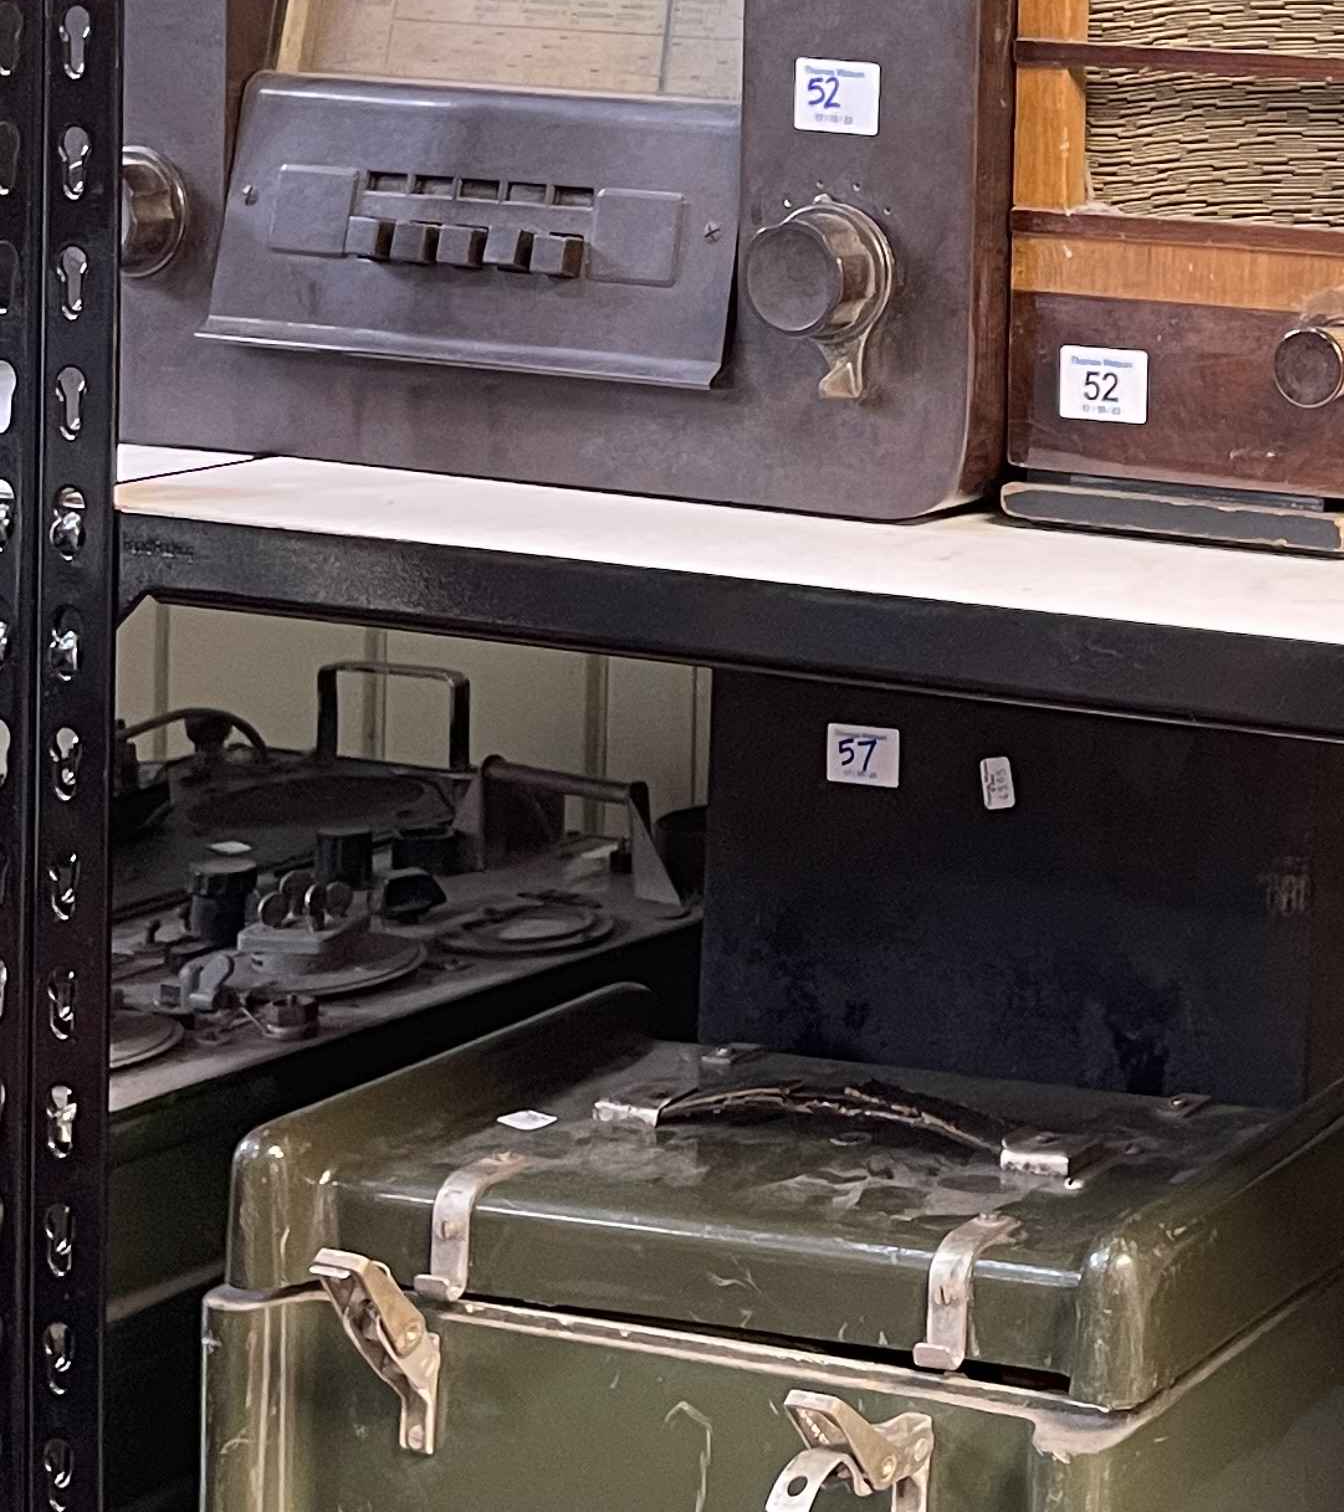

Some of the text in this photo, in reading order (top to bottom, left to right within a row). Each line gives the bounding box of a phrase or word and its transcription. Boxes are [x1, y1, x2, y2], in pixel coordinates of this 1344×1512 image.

[808, 77, 841, 109] 52
[1083, 370, 1119, 403] 52
[838, 738, 878, 773] 57
